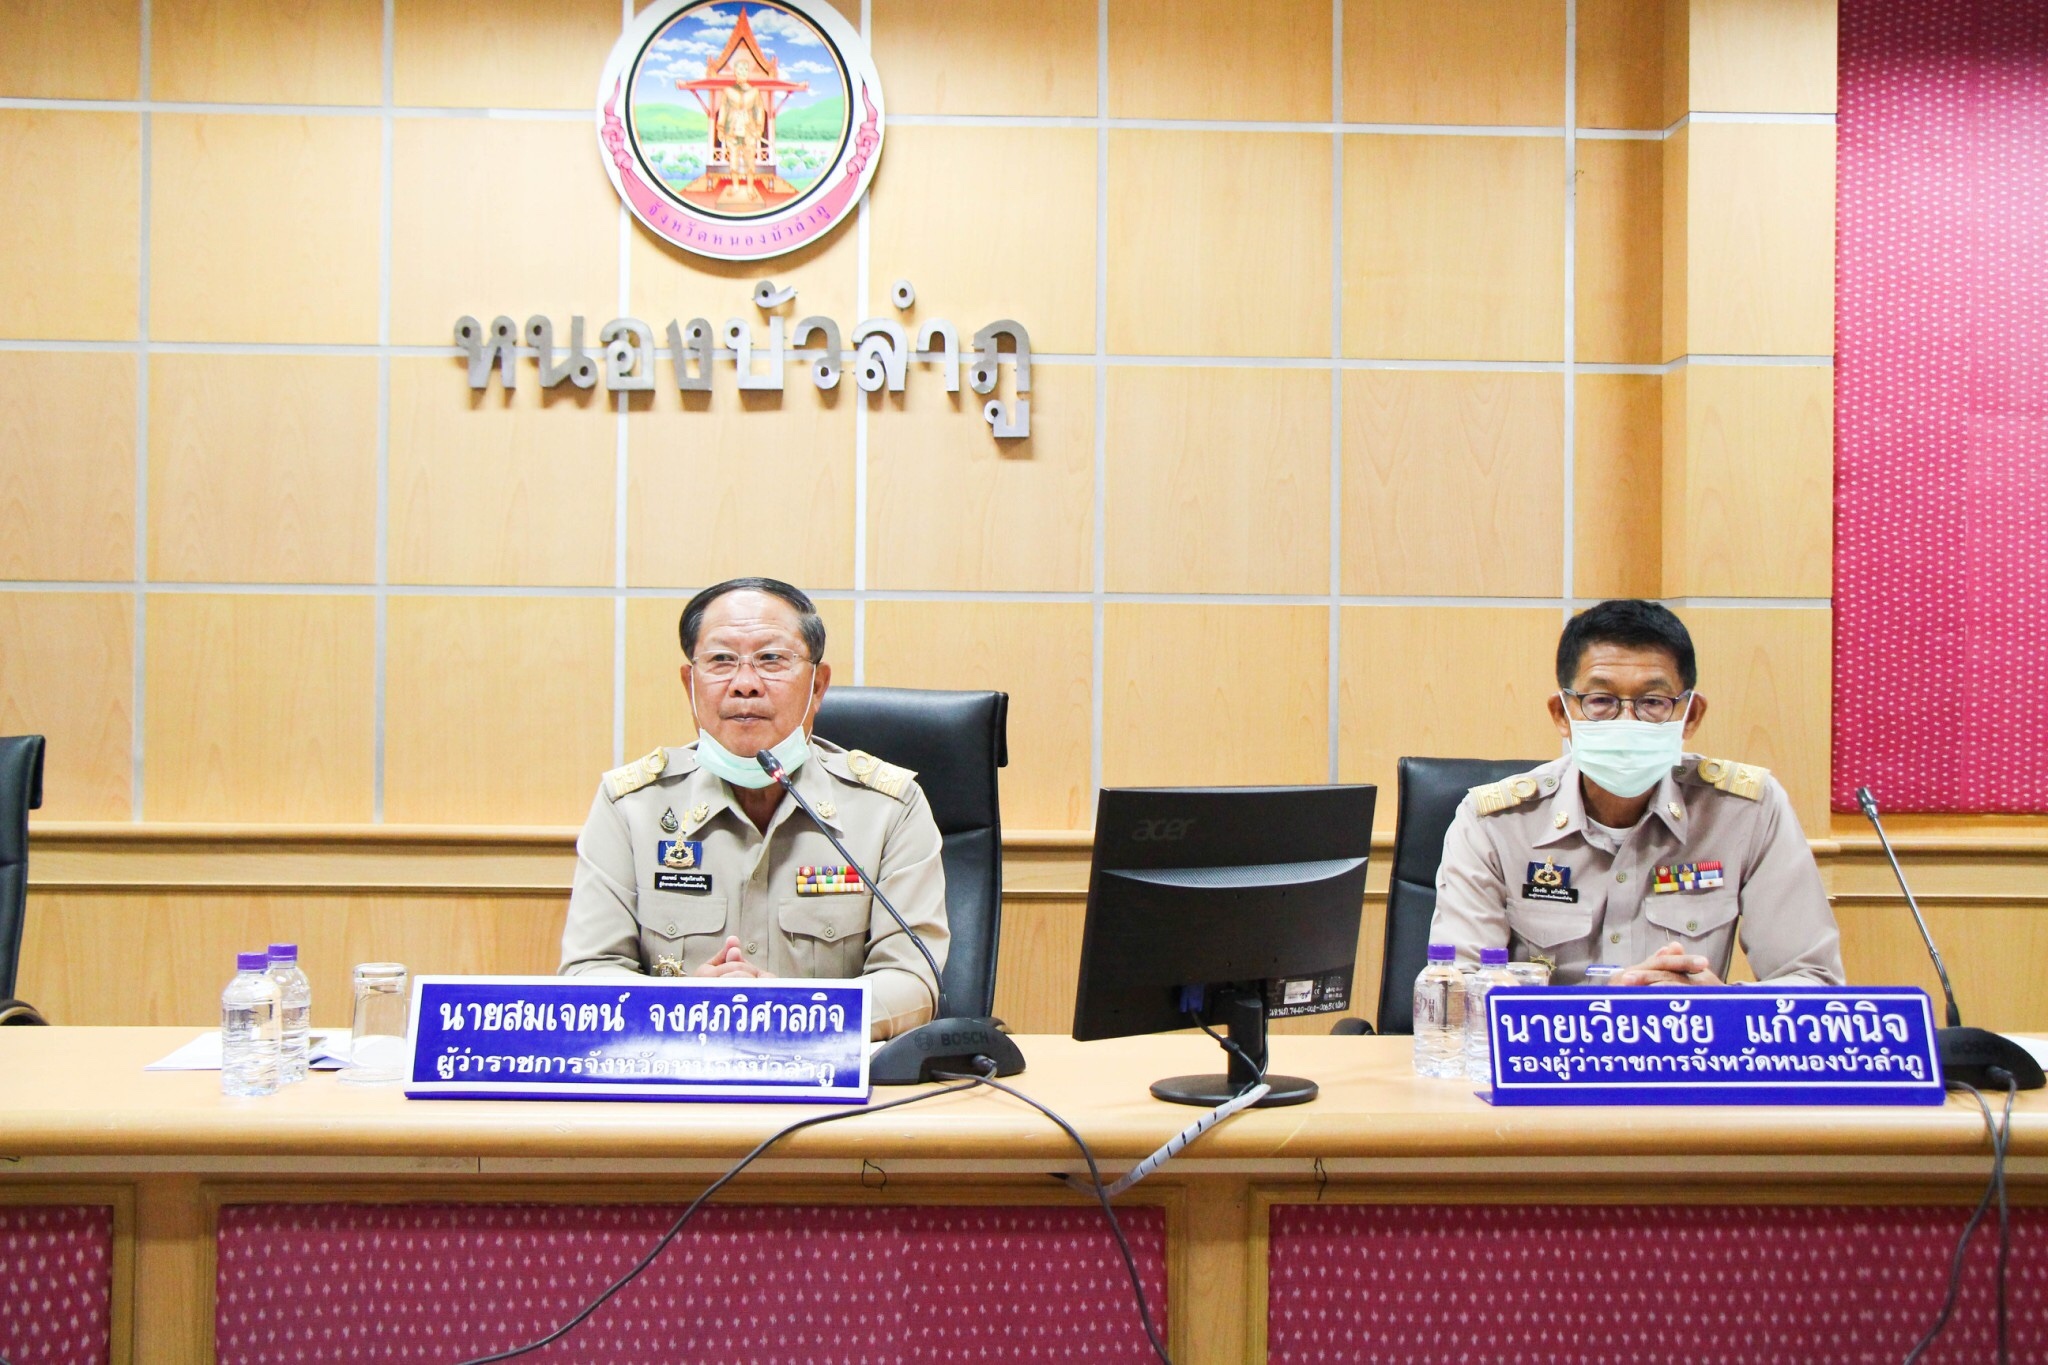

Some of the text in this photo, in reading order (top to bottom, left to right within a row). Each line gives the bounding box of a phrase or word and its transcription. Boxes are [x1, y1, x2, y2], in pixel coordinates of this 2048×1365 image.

[453, 280, 1031, 438] หนองบัวลำภู
[1131, 817, 1195, 841] acer
[439, 992, 845, 1046] นายสมเจตน์ จงศุภวิศาลกิจ
[941, 1031, 988, 1046] BOSCH
[1501, 998, 1909, 1044] นายเวียงชัย แก้วพินิจ
[1508, 1047, 1924, 1080] รองผู้ว่าราชการจังหวัดหนองบัวลำภู
